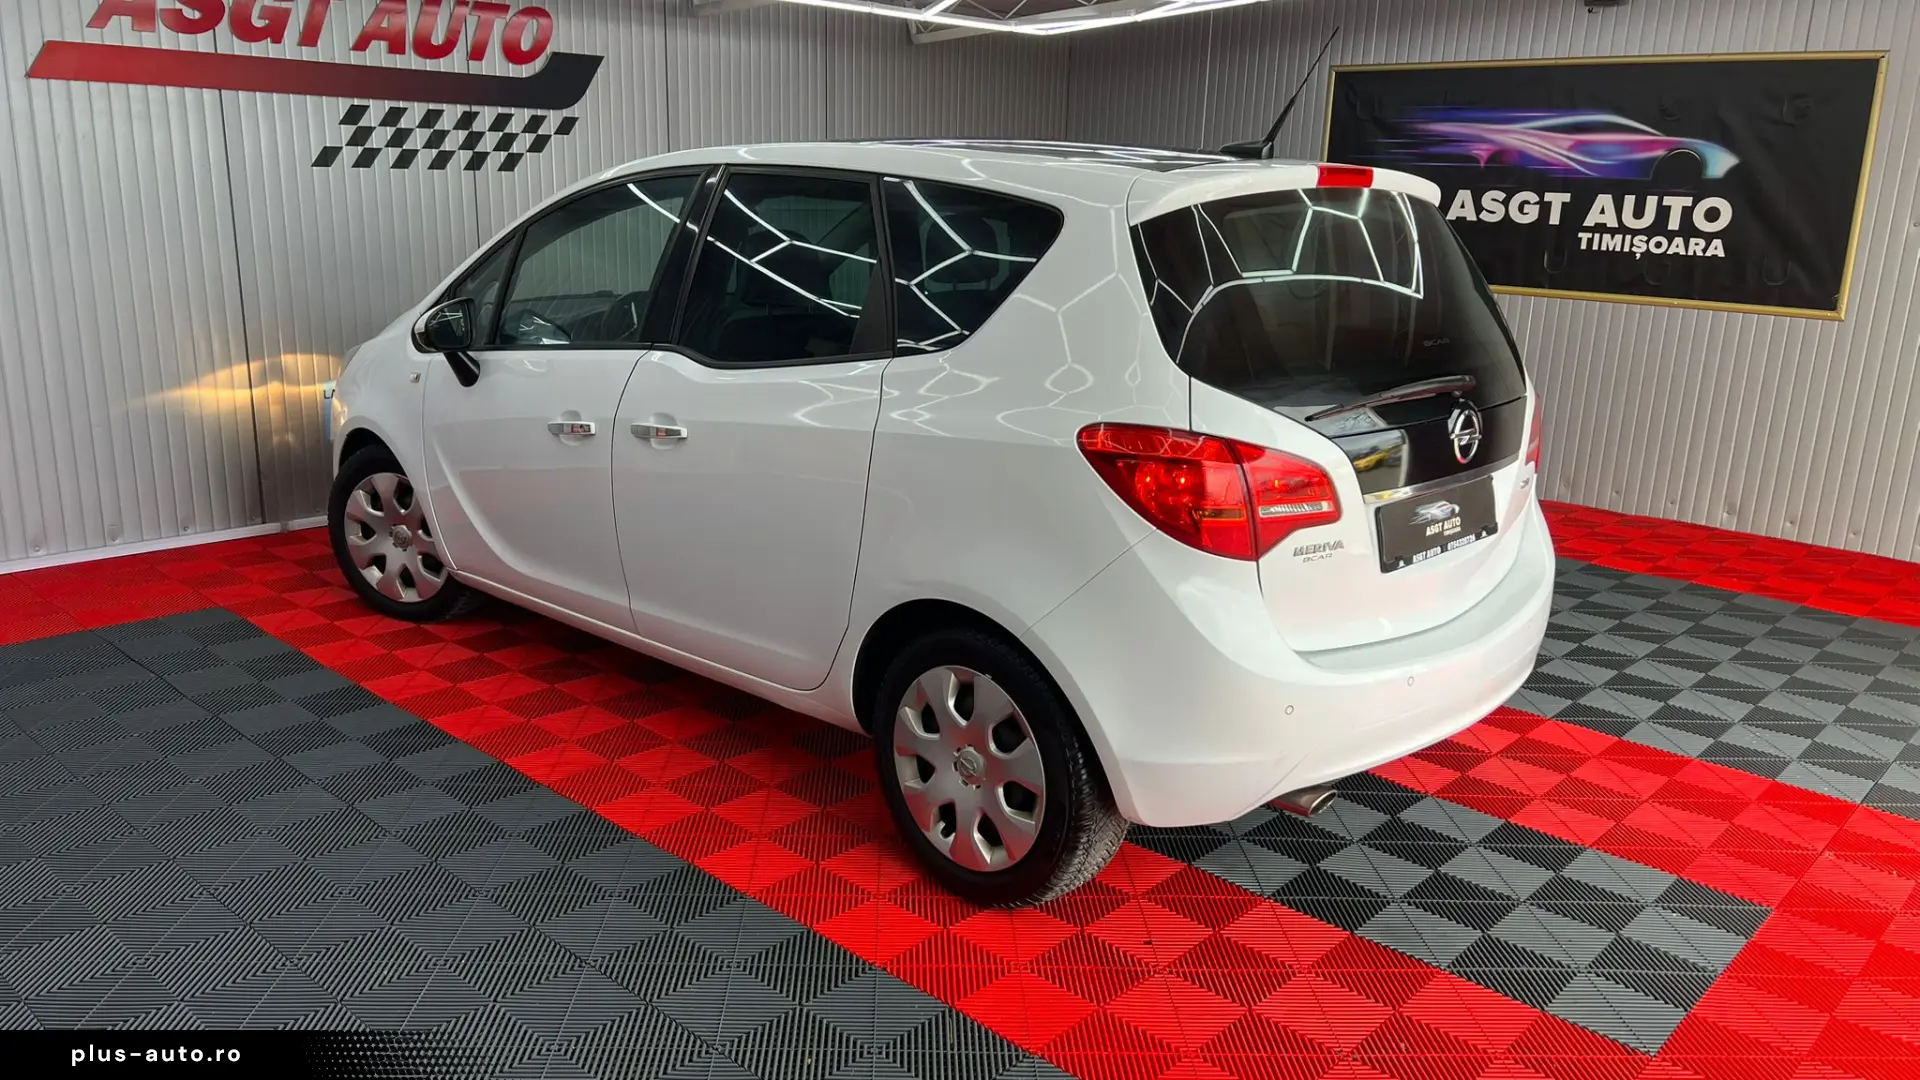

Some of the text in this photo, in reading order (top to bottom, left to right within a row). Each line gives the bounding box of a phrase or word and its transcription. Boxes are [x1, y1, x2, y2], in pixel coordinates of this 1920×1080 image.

[349, 0, 553, 65] AUTO
[1446, 189, 1733, 233] ASGT AUTO
[1577, 232, 1726, 260] TIMIȘOARA
[1426, 522, 1442, 536] ASGT
[1443, 516, 1461, 530] AUTO
[1293, 539, 1344, 557] MERIVA
